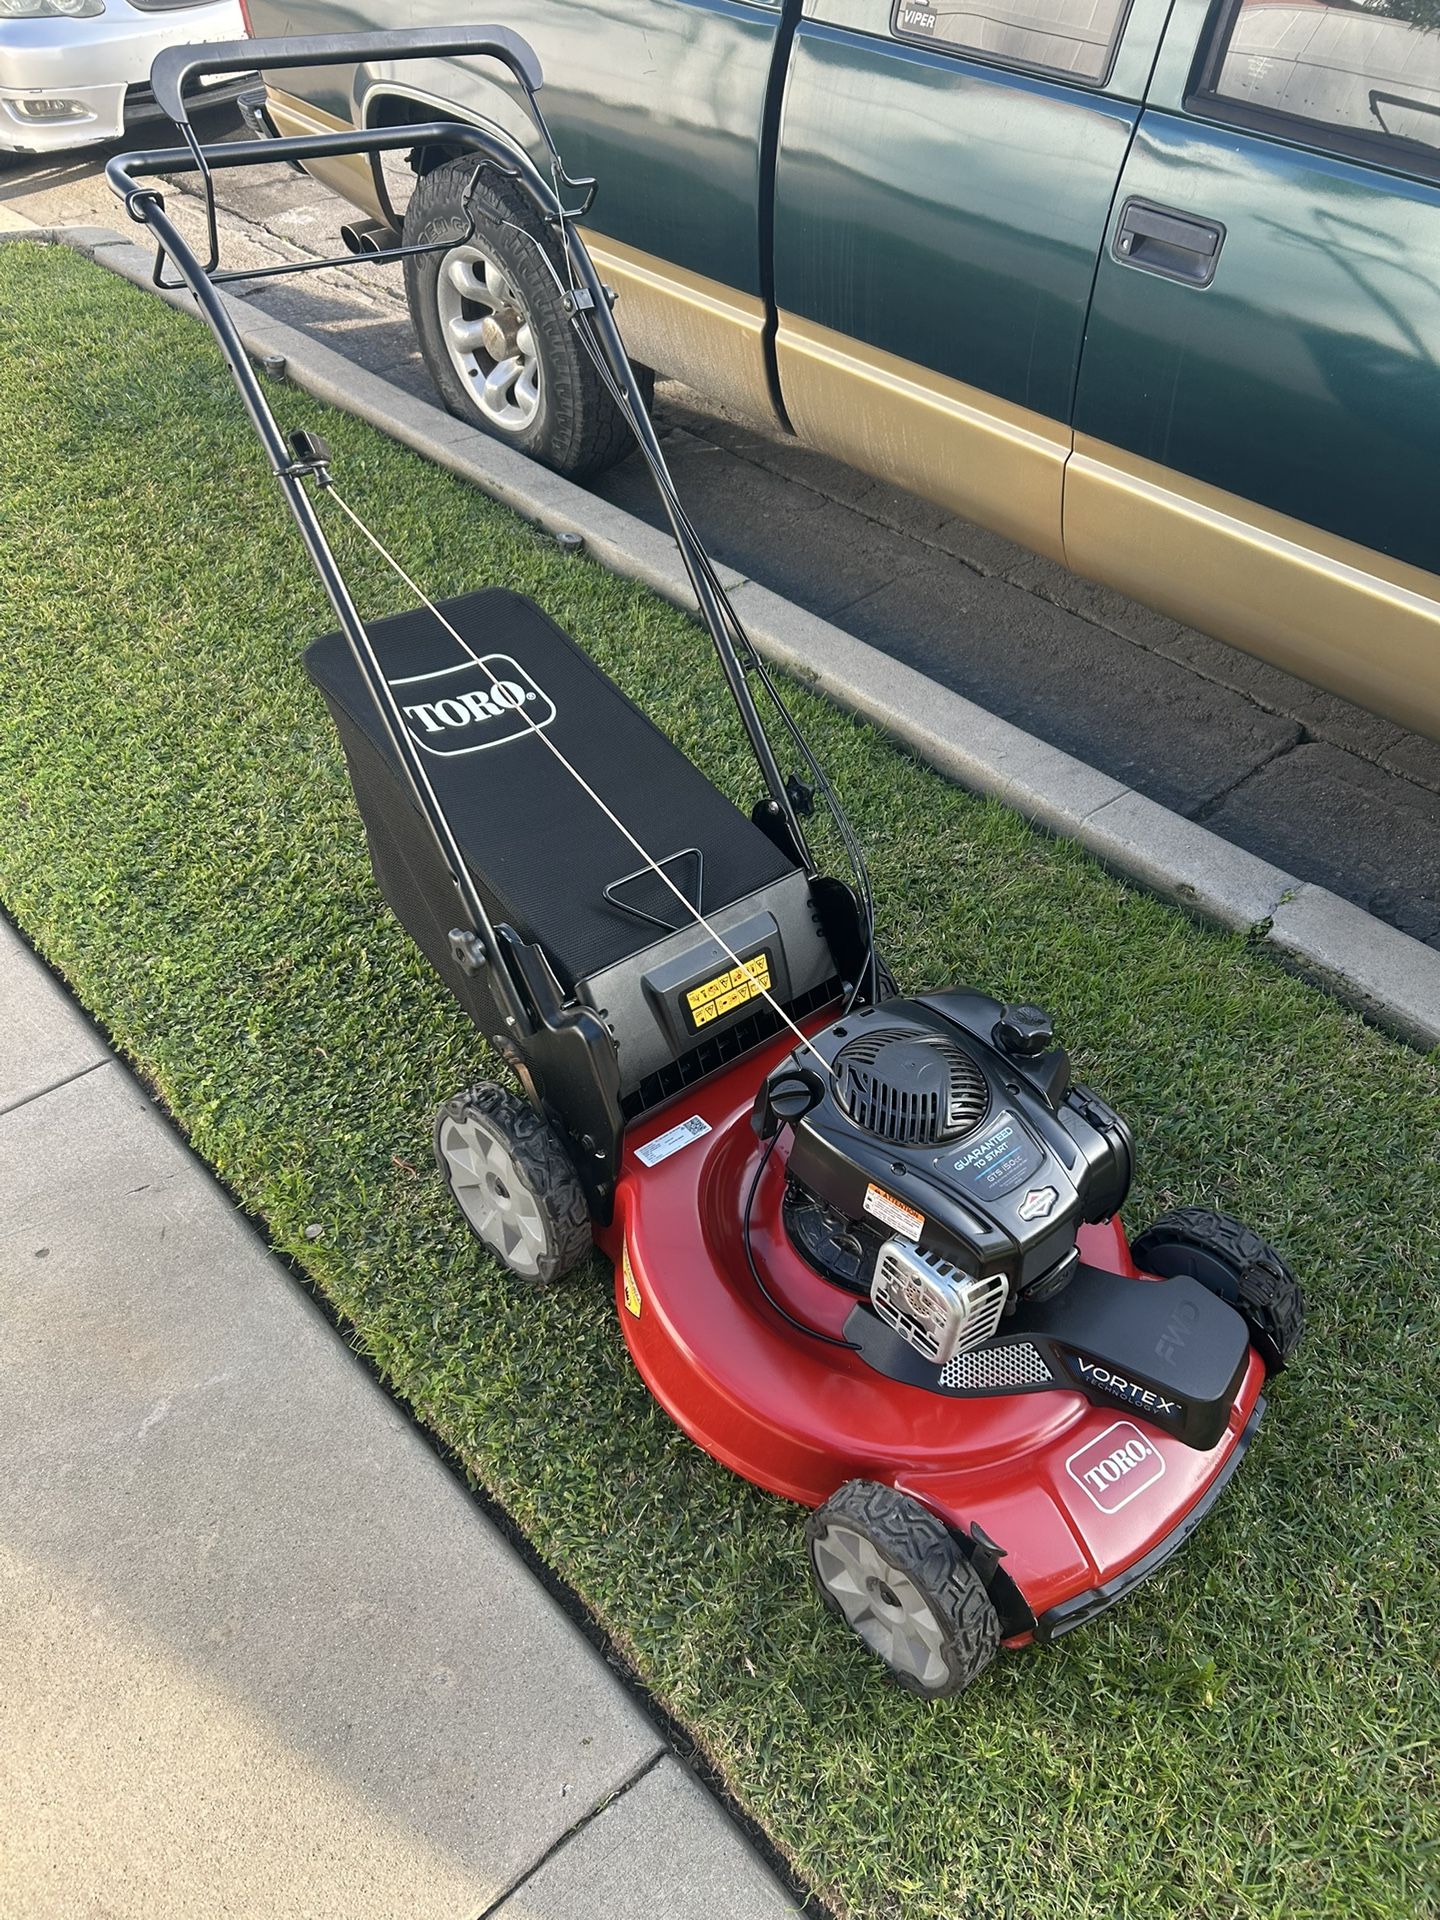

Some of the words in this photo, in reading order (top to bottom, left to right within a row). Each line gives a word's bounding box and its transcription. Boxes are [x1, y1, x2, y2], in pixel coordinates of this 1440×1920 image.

[904, 9, 935, 28] VIPER
[402, 680, 526, 732] TORO
[953, 1126, 1013, 1171] GUARANTEED
[973, 1158, 986, 1169] TO
[985, 1142, 1008, 1161] START
[987, 1168, 1003, 1182] GTS
[1001, 1155, 1023, 1171] 150cc
[883, 1193, 919, 1218] ATTENTION
[1155, 1301, 1199, 1367] FWD
[1078, 1357, 1175, 1413] VORTEX
[1085, 1375, 1160, 1414] TECHNOLOGY
[1083, 1439, 1147, 1492] TORO
